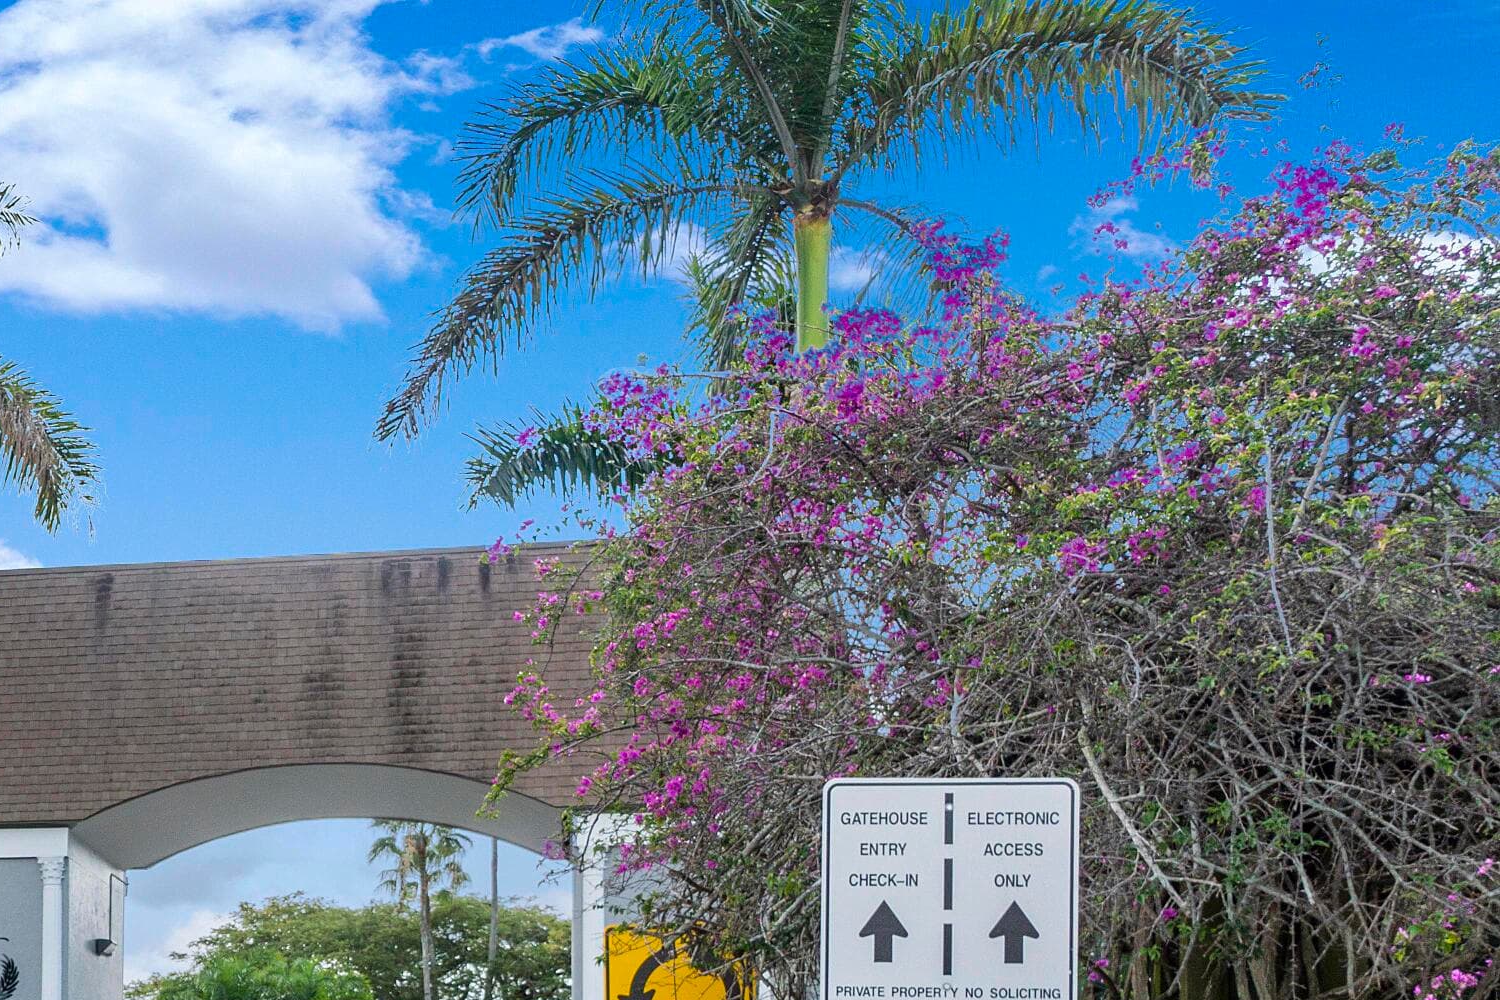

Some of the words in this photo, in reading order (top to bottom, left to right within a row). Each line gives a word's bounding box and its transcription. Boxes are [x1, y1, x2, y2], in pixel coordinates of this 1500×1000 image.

[840, 811, 928, 826] GATEHOUSE
[967, 811, 1060, 826] ELECTRONIC
[860, 842, 907, 856] ENTRY
[983, 842, 1044, 857] ACCESS
[849, 873, 919, 887] CHECK-IN
[994, 874, 1032, 888] ONLY
[836, 986, 885, 997] PRIVATE
[891, 987, 958, 998] PROPERTY
[965, 987, 984, 998] NO
[990, 988, 1061, 999] SOLICITING
